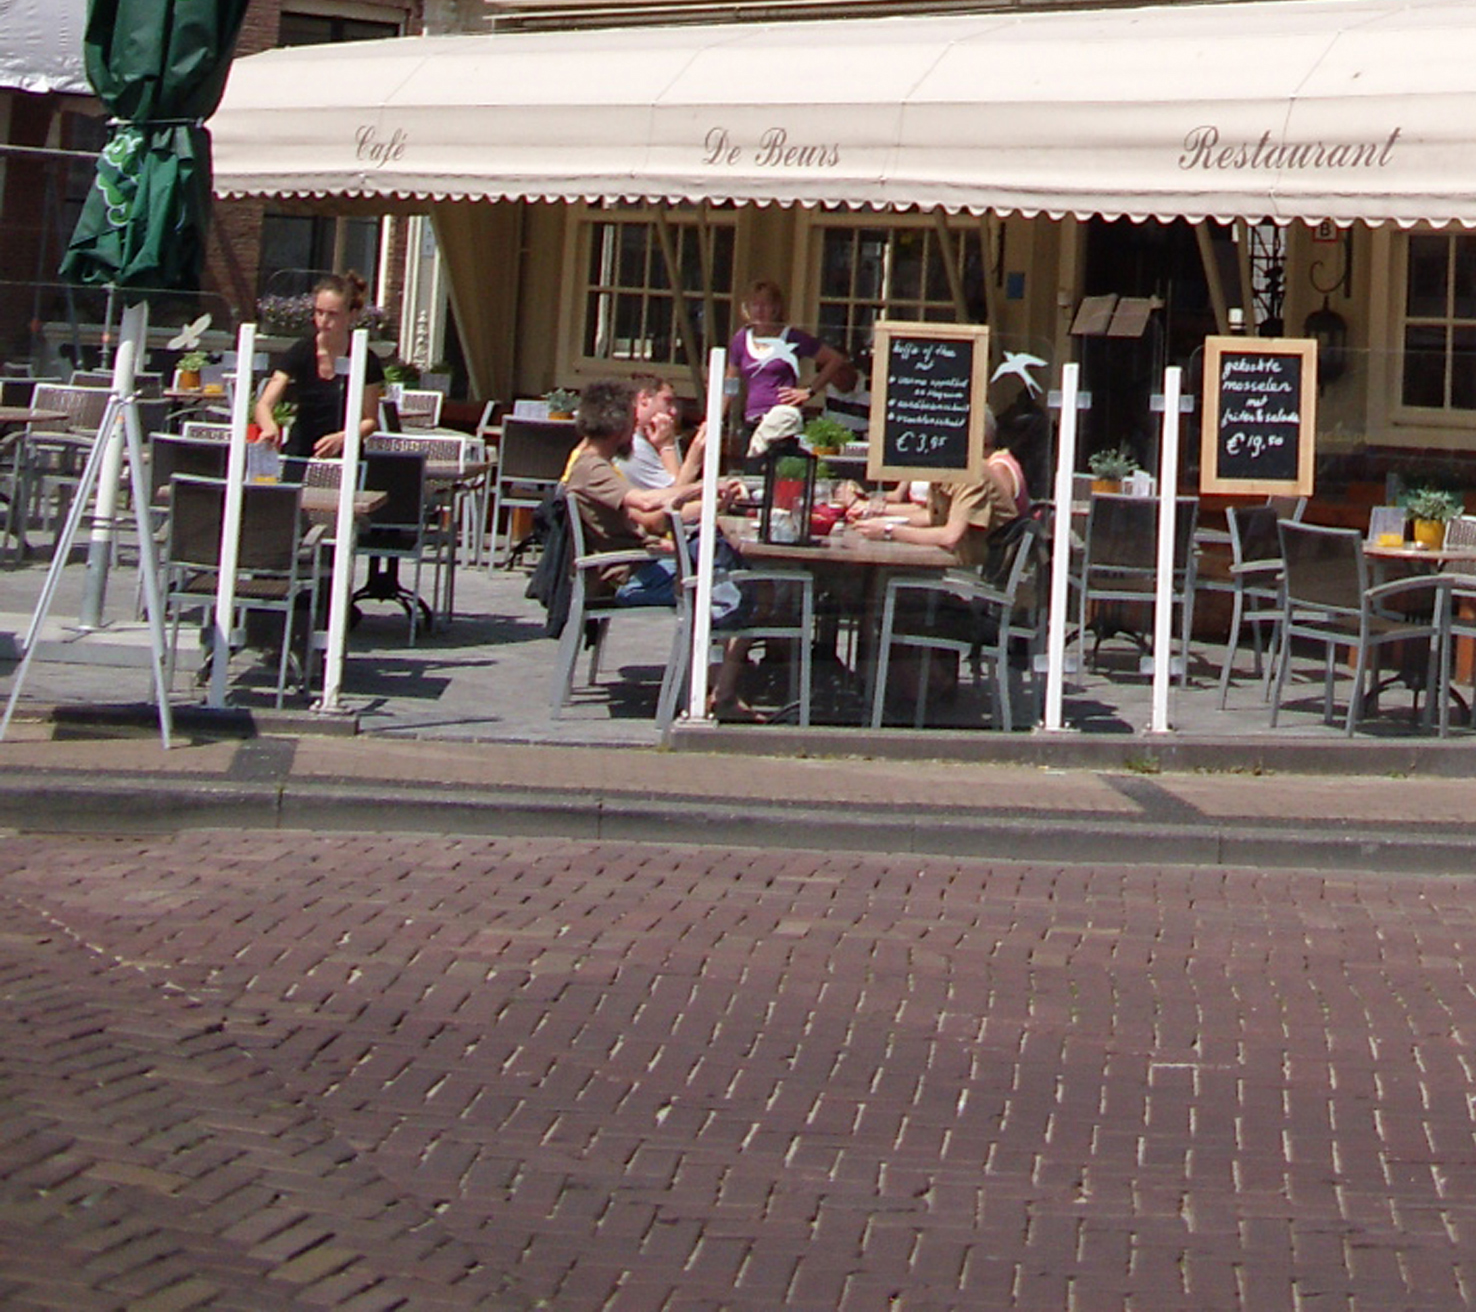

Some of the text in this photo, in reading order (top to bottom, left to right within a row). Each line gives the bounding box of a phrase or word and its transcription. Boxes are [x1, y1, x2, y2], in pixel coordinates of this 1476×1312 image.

[354, 125, 408, 169] Café
[702, 126, 840, 167] De Beurs
[1178, 125, 1402, 170] Restaurant
[1222, 377, 1293, 393] mosselen
